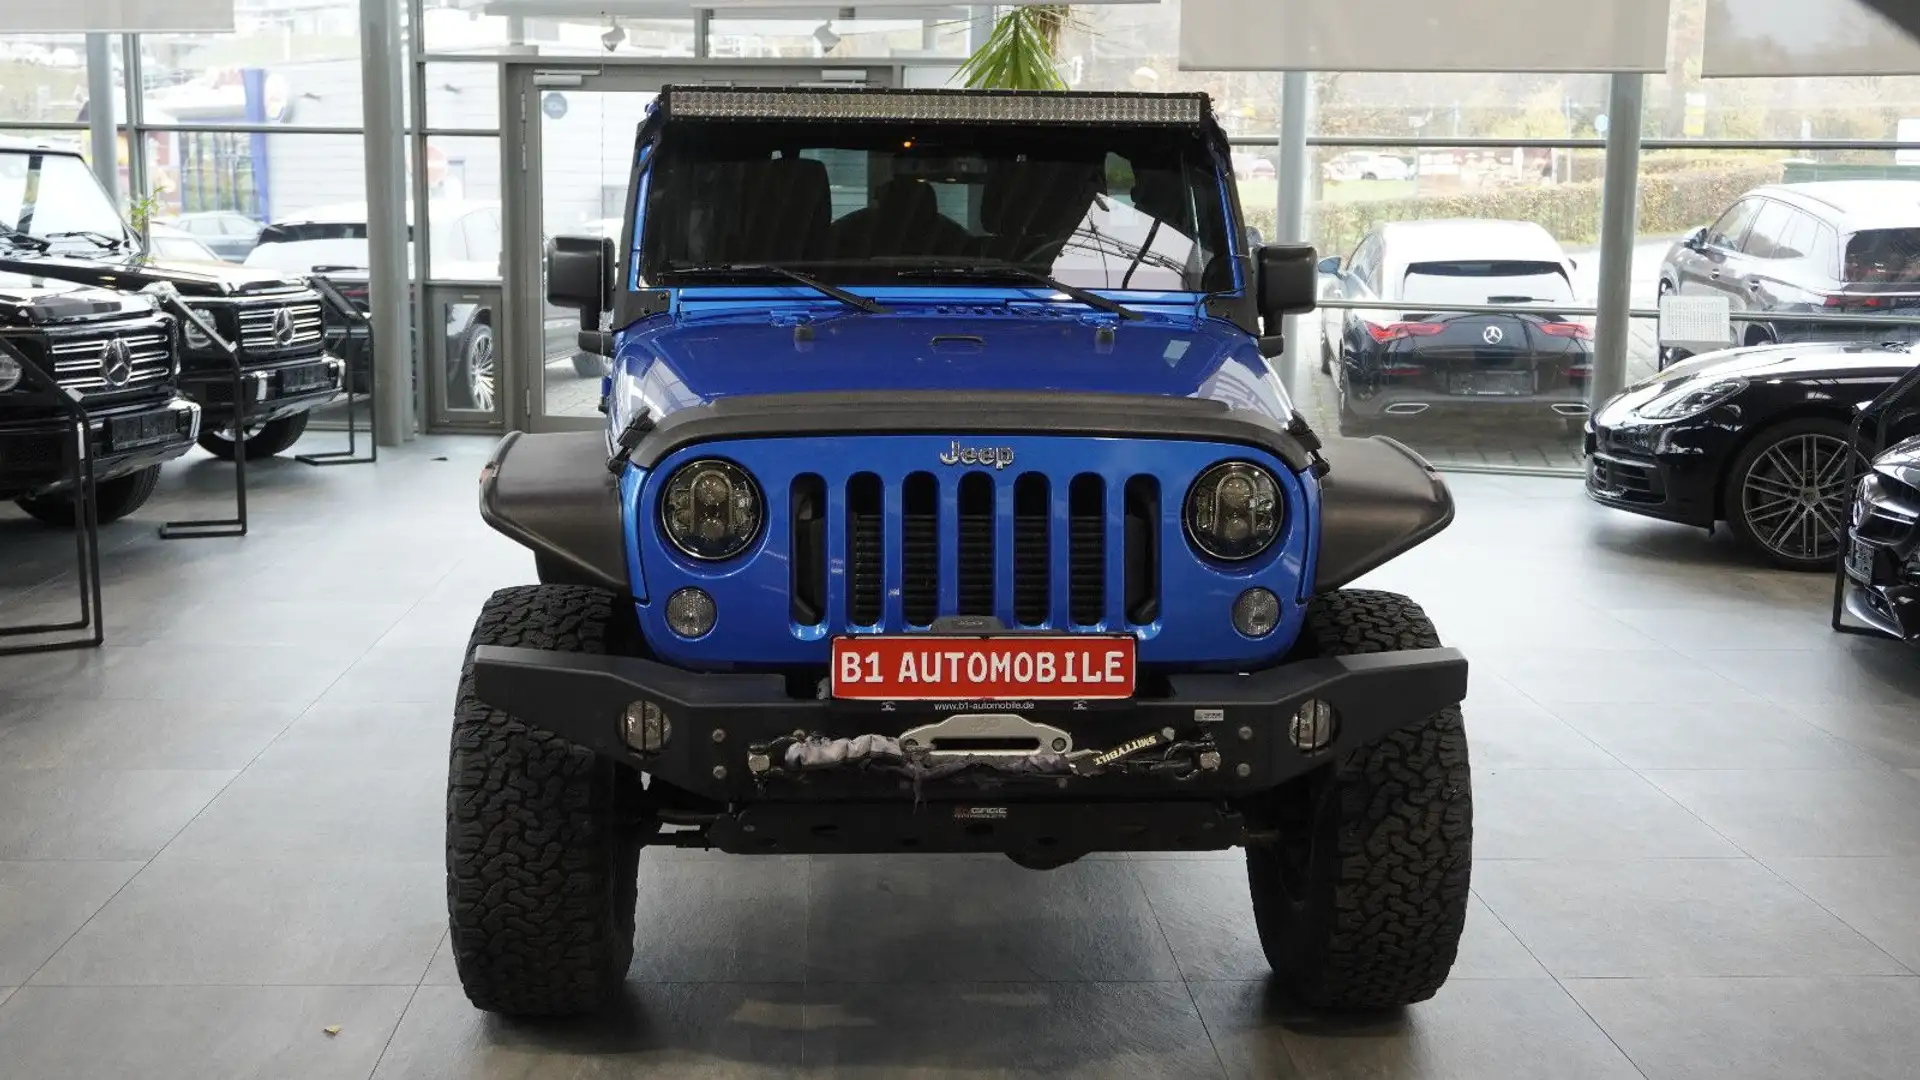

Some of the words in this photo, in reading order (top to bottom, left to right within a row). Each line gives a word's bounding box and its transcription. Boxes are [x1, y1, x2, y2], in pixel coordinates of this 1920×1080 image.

[940, 440, 1014, 469] Jeep
[841, 652, 883, 682] B1
[898, 651, 1125, 682] AUTOMOBILE
[934, 701, 1035, 710] www.b1-automobile.de
[1093, 735, 1157, 766] SMITTYBILT
